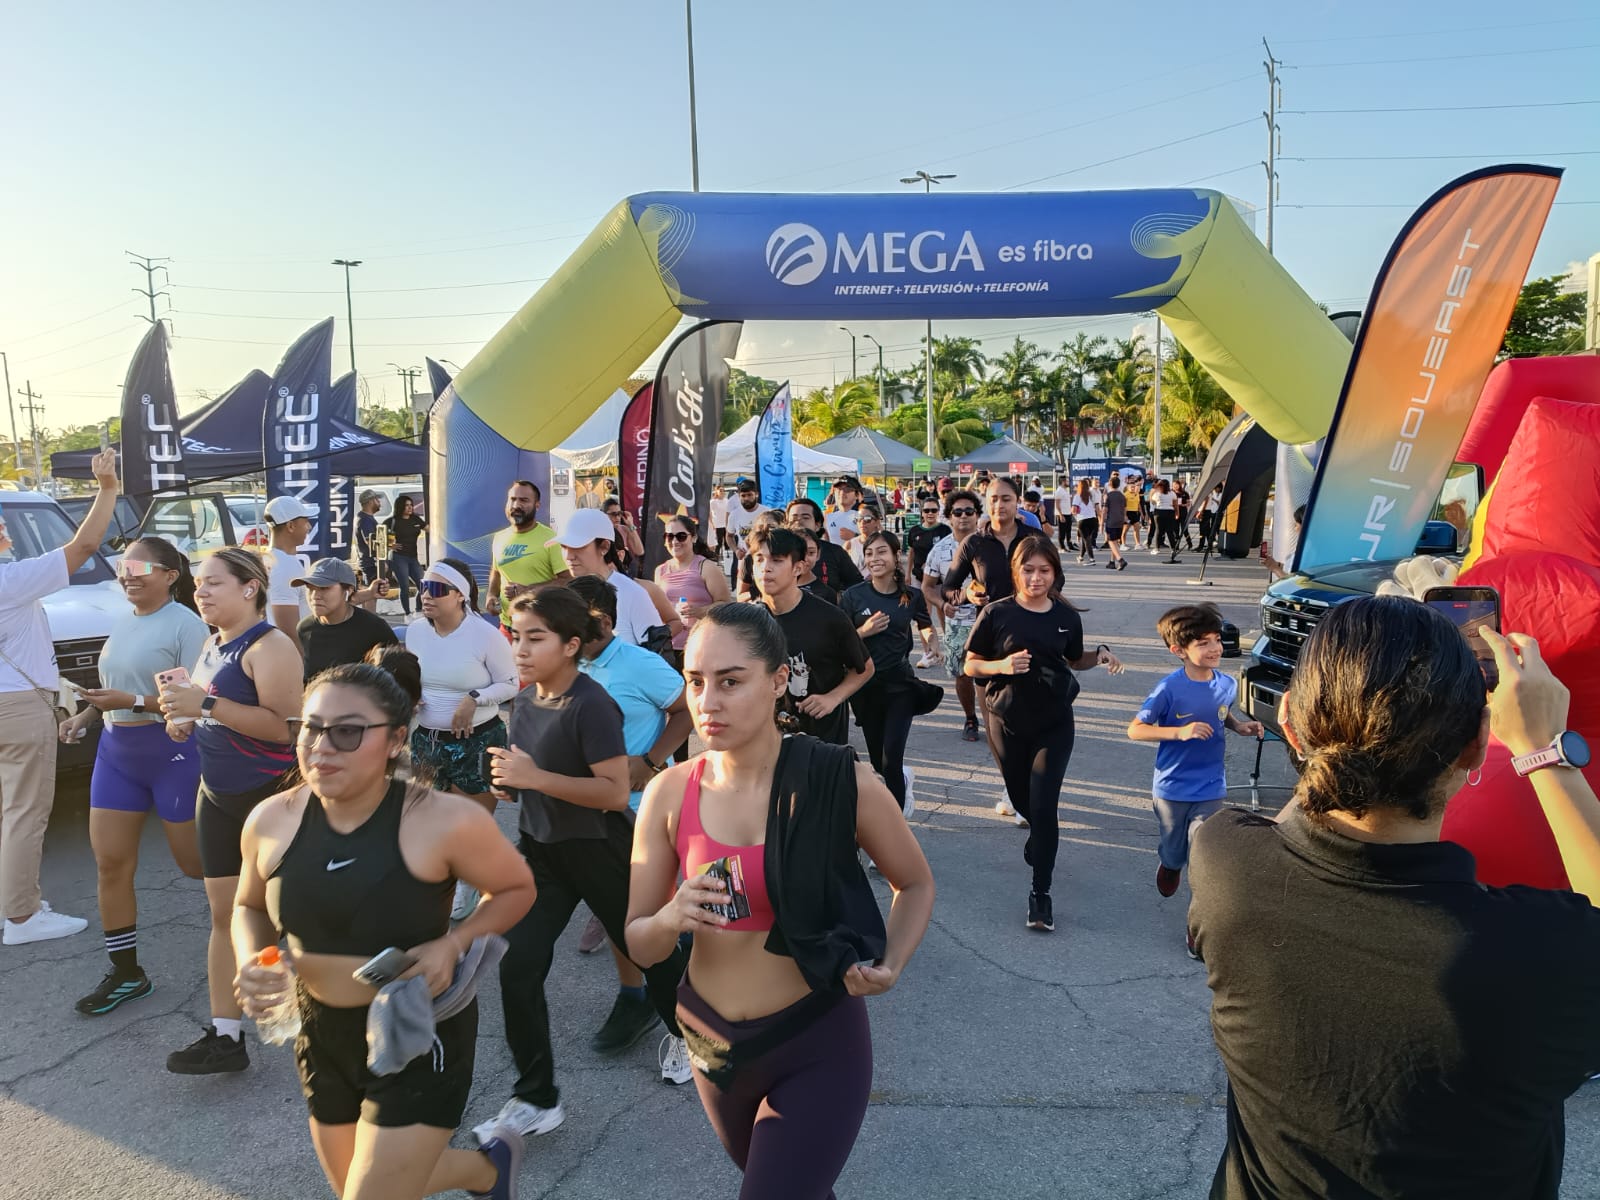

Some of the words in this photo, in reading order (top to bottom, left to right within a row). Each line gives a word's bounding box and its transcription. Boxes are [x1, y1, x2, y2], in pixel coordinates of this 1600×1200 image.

[832, 230, 985, 274] MEGA
[998, 245, 1026, 263] es
[1033, 239, 1093, 262] fibra
[1388, 227, 1481, 473] SOUEAST
[668, 423, 696, 508] Carl's
[329, 477, 349, 549] PRIN
[504, 544, 528, 557] NIKE
